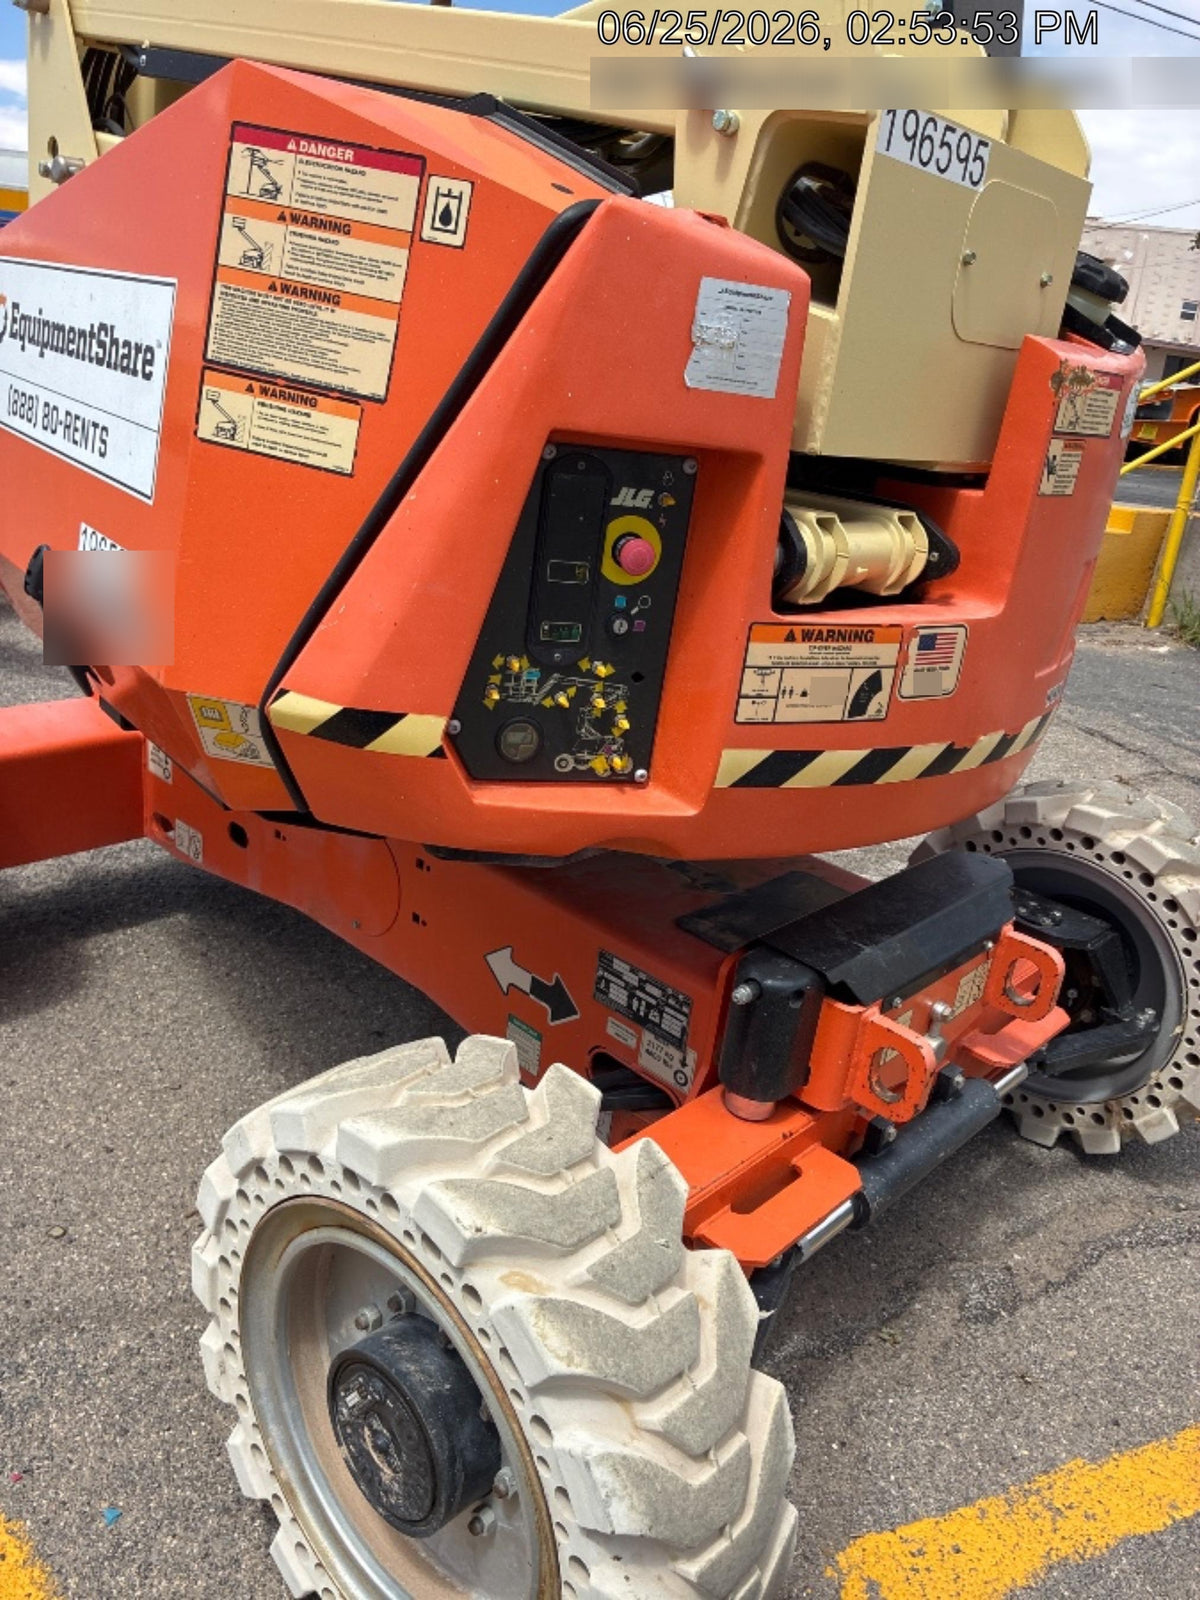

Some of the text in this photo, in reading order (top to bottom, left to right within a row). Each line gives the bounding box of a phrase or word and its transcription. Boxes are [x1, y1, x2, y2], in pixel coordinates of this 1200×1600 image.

[299, 141, 355, 163] DANGER
[886, 109, 989, 187] 196595
[290, 212, 352, 236] WARNING
[280, 281, 342, 307] WARNING
[9, 301, 156, 382] EquipmentShare
[259, 384, 319, 408] WARNING
[7, 383, 110, 459] (888) 80-RENTS
[609, 486, 656, 510] JLG
[800, 628, 876, 644] WARNING
